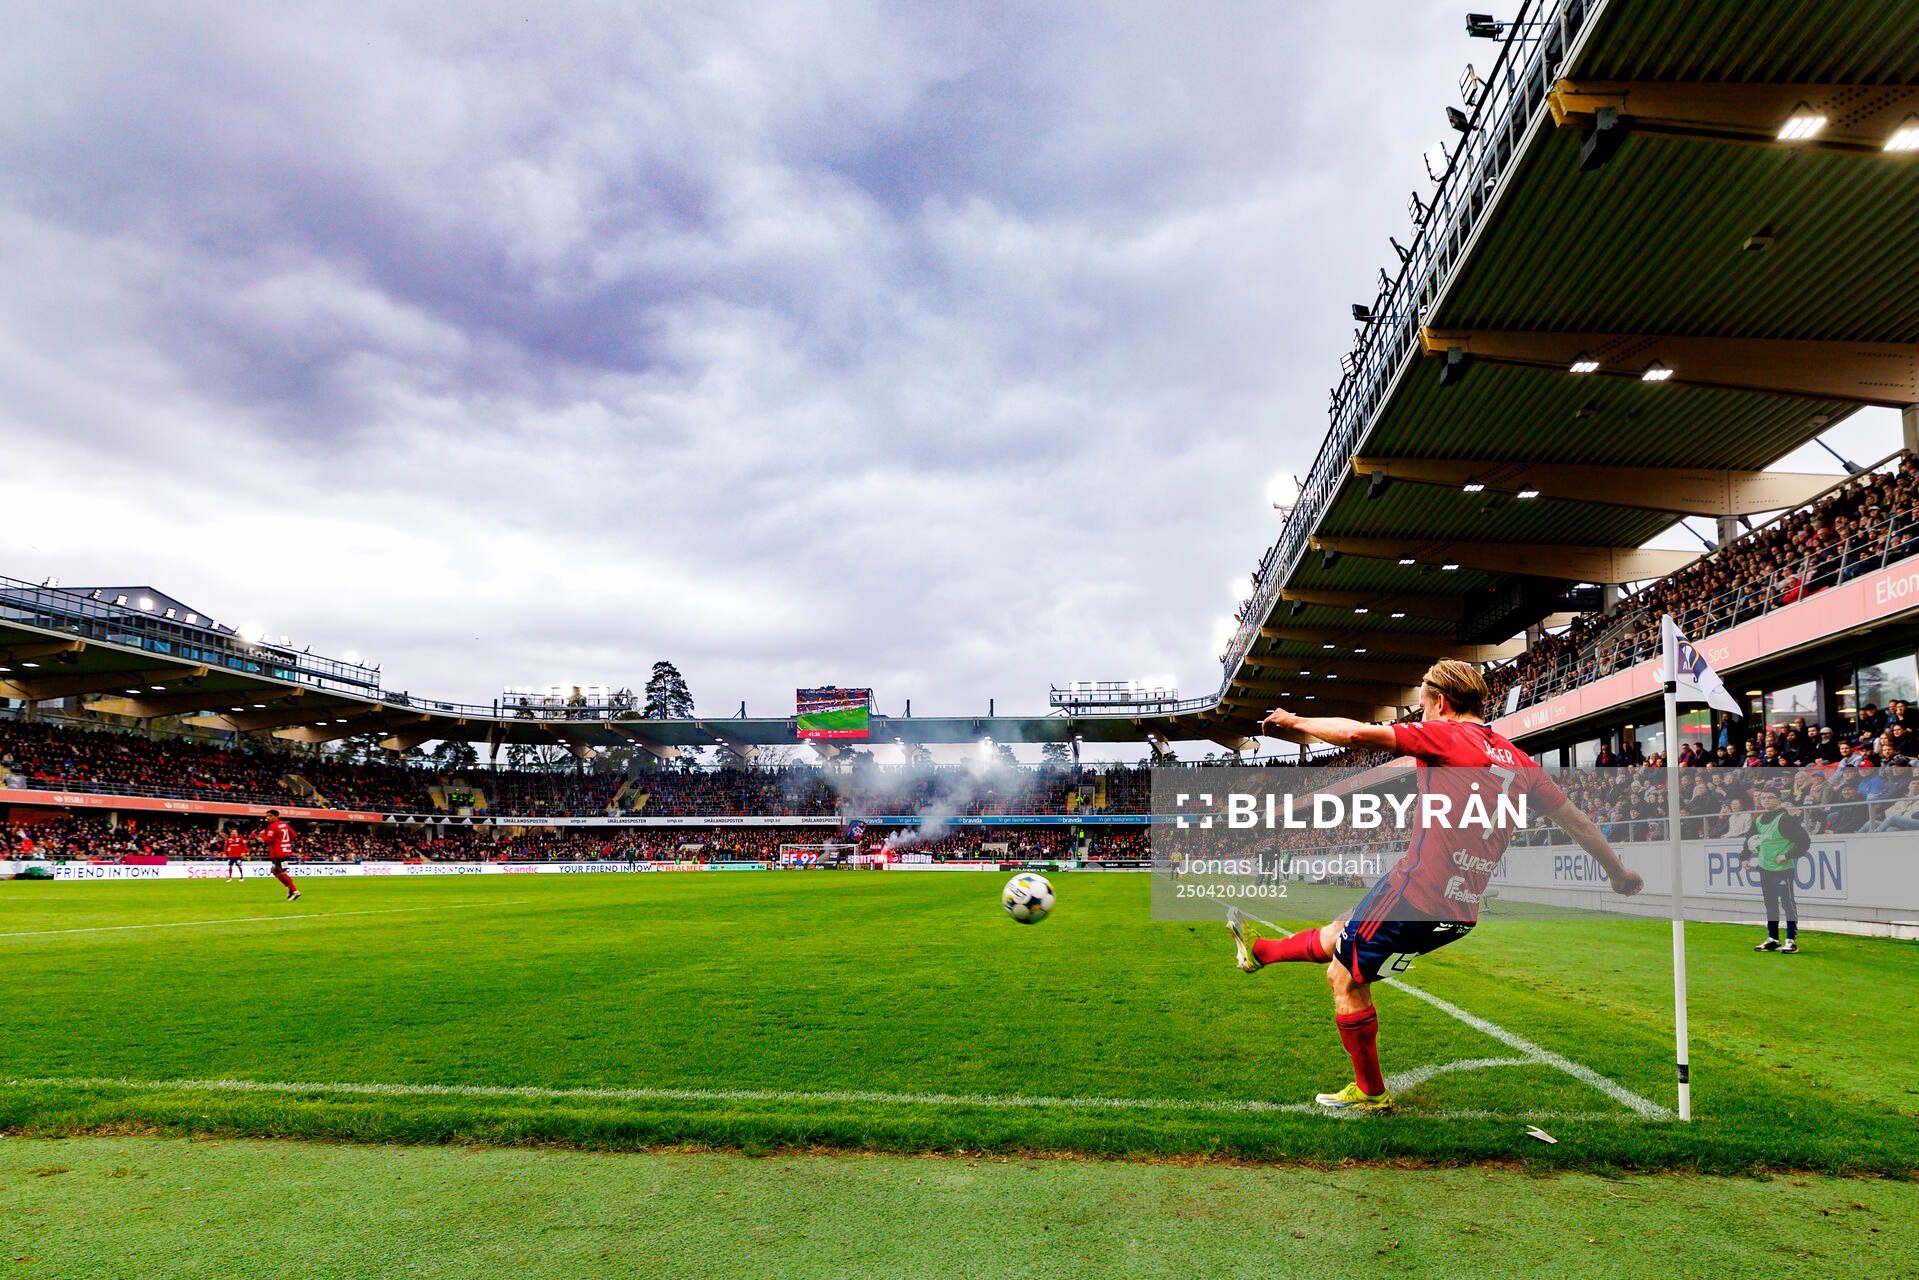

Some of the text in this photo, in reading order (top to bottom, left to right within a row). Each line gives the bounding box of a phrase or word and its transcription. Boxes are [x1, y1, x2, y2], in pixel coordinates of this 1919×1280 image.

[55, 867, 159, 878] FRIEND IN TOWN
[503, 866, 539, 875] Scandic
[559, 865, 584, 873] YOUR
[586, 865, 618, 873] FRIEND
[1708, 850, 1842, 891] PREON
